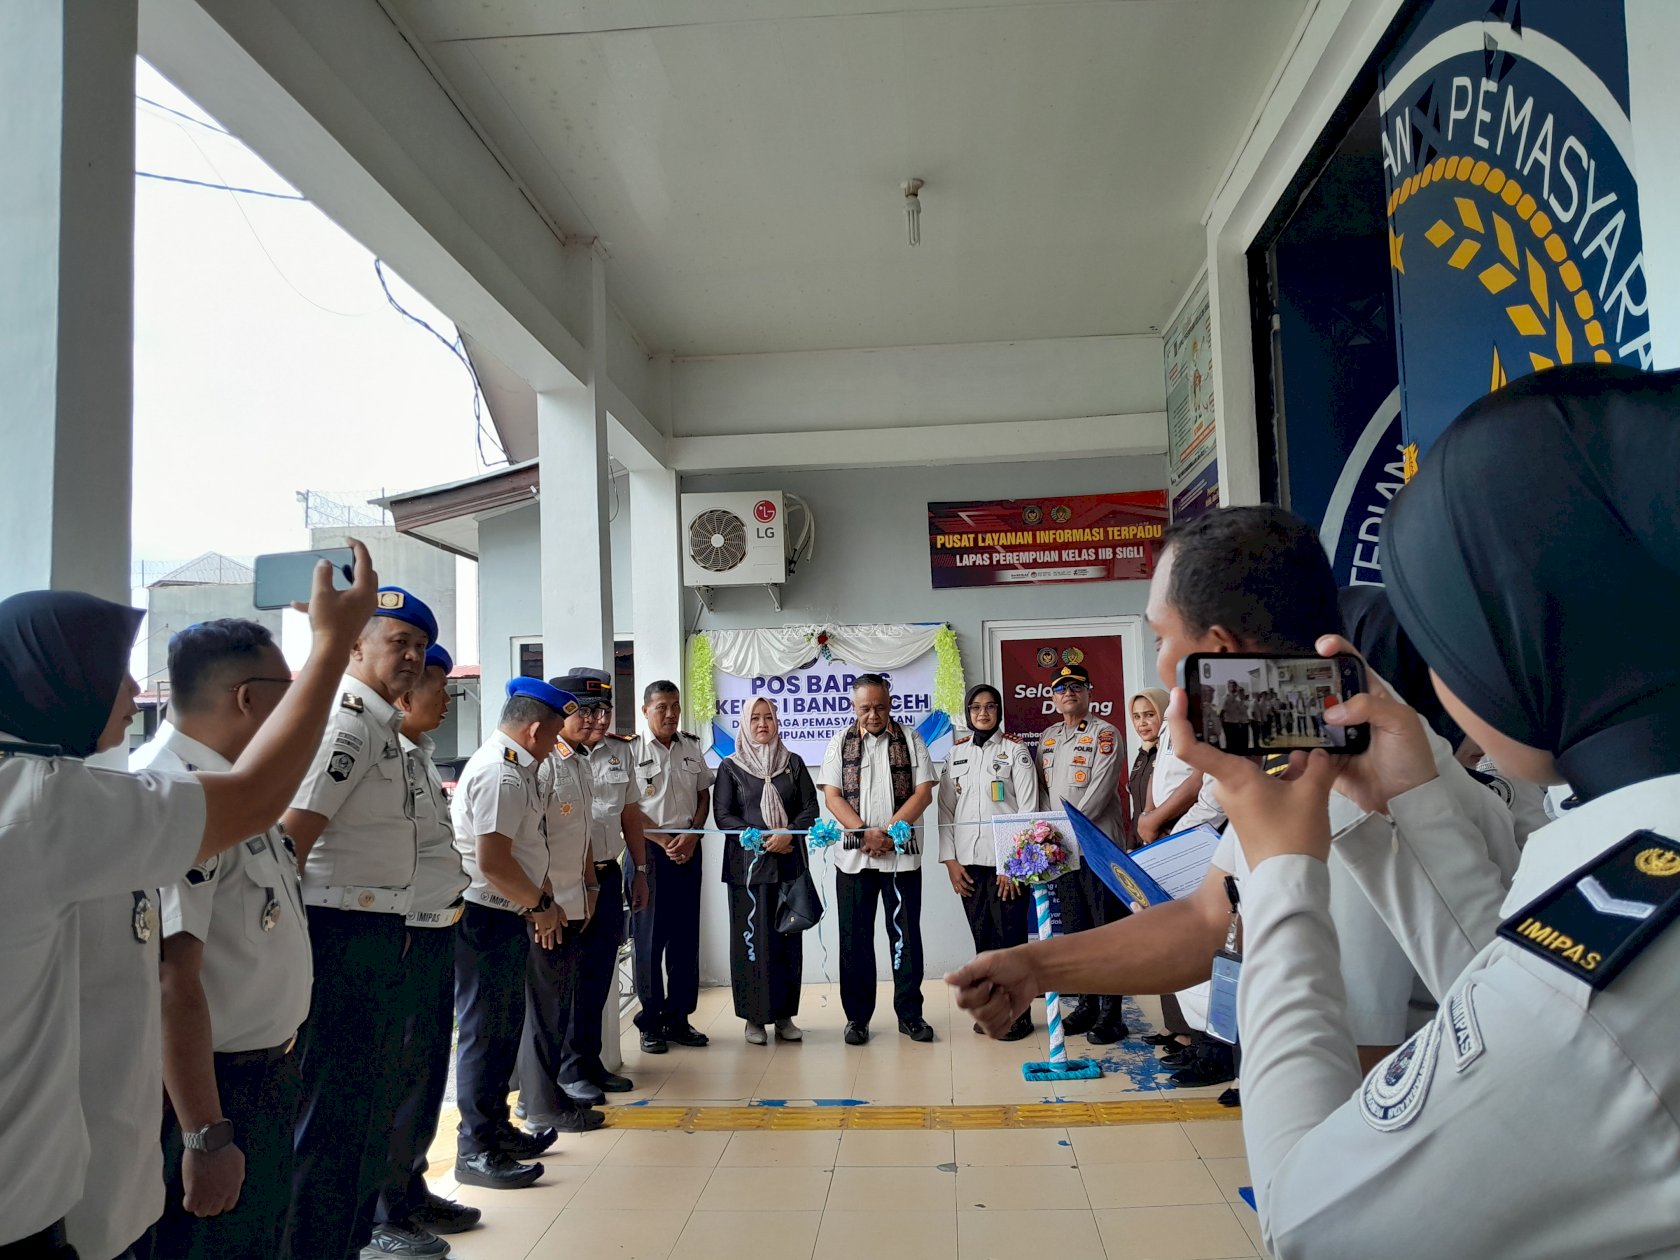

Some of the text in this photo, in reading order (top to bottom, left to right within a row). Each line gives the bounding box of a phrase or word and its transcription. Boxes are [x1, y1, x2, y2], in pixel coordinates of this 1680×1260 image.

[756, 527, 775, 539] LG
[936, 525, 1162, 549] PUSAT LAYANAN INFORMASI TERPADU
[956, 546, 1144, 567] LAPAS PEREMPUAN KELAS IIB SIGLI
[751, 673, 892, 695] POS BAPS
[716, 698, 779, 715] KES
[793, 694, 855, 713] BAND
[889, 693, 929, 711] CEH
[488, 894, 511, 908] IMIPAS
[416, 911, 441, 923] IMIPAS
[1516, 917, 1602, 971] IMIPAS
